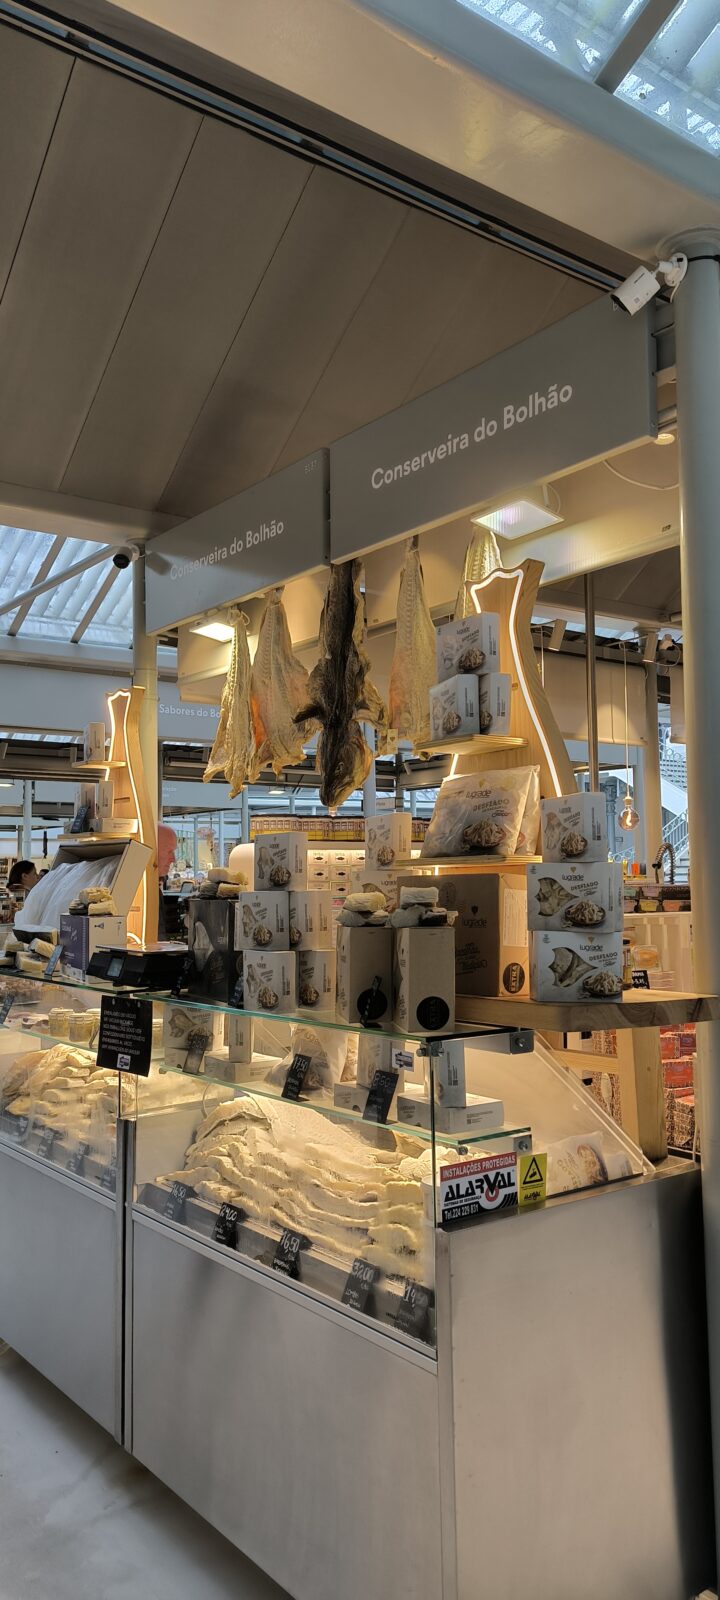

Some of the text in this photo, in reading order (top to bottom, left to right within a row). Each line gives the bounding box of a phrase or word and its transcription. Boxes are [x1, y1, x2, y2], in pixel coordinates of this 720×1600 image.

[371, 383, 573, 489] Conserveira do Bolhão
[170, 520, 284, 580] Conserveira do Bolhão
[159, 704, 195, 717] Sabores
[197, 708, 208, 717] do
[443, 1155, 516, 1178] INSTALAÇÕES PROTEGIDAS
[444, 1171, 516, 1202] ALARVAL
